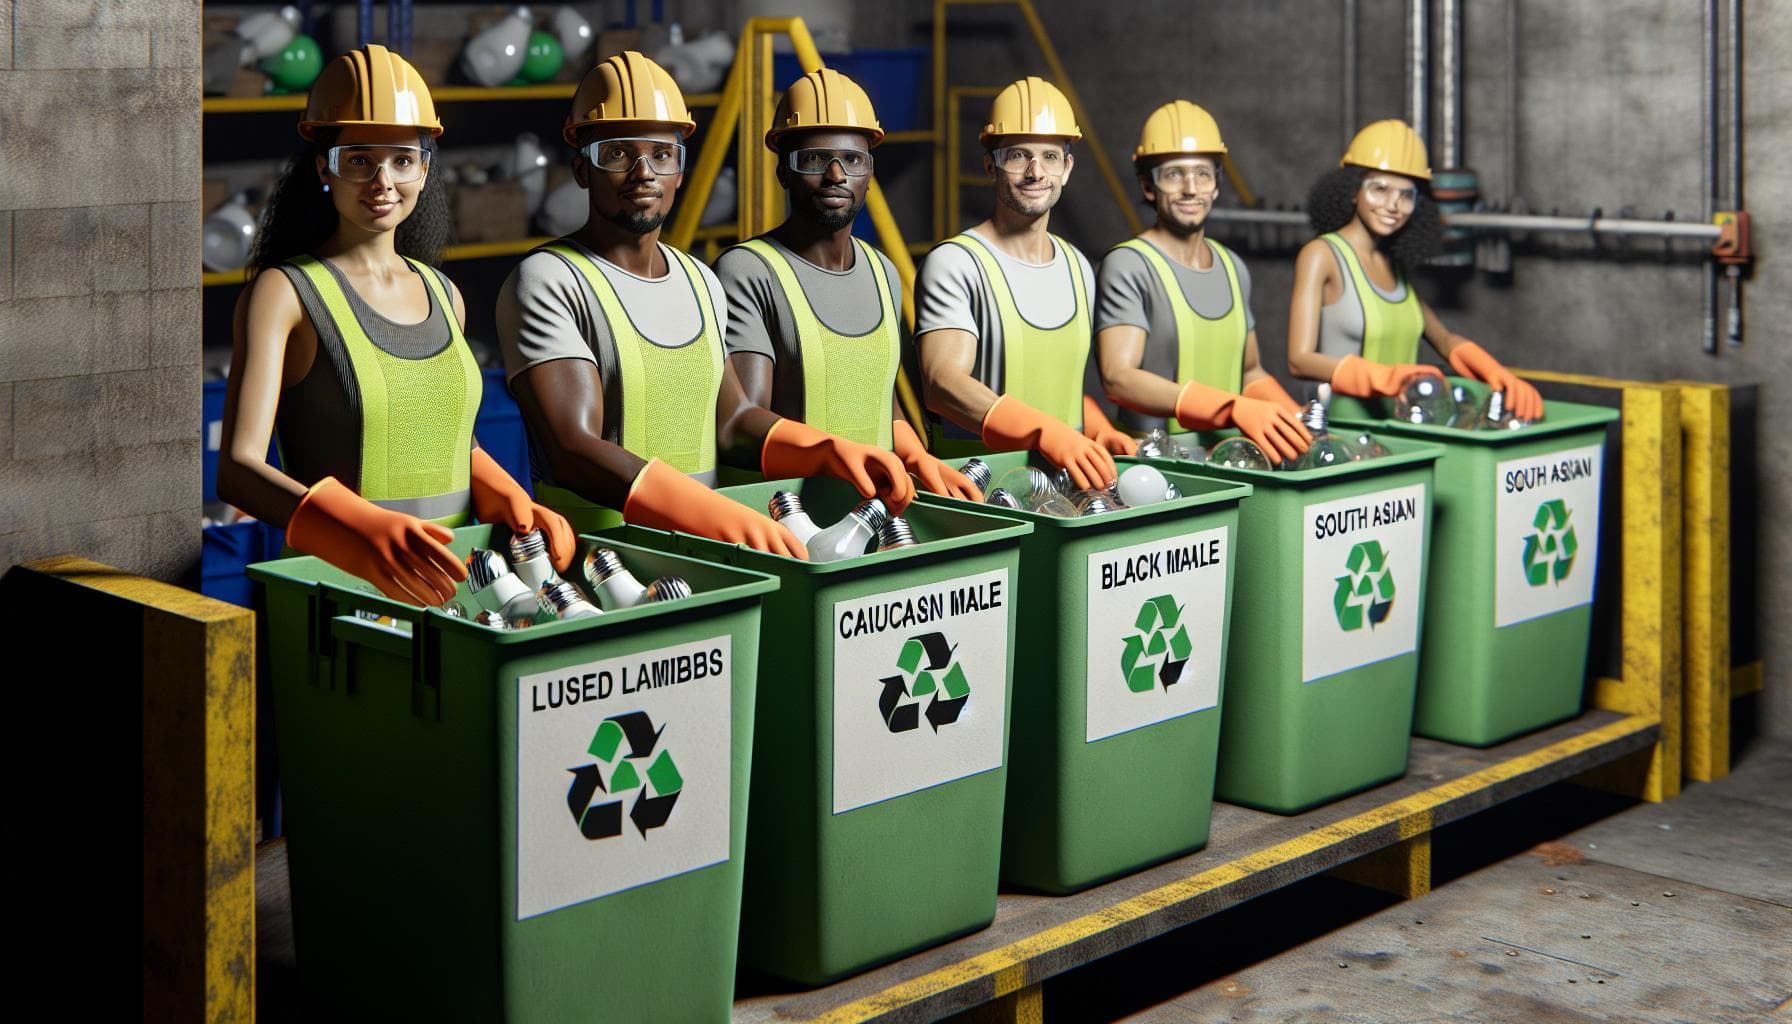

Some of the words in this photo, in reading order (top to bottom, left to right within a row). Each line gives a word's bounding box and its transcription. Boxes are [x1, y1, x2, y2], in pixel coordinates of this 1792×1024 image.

[1315, 506, 1367, 539] SOUTH
[1372, 497, 1415, 527] ASIAN
[1102, 551, 1161, 589] BLACK
[950, 581, 1001, 616] MALE
[532, 671, 613, 712] LUSED
